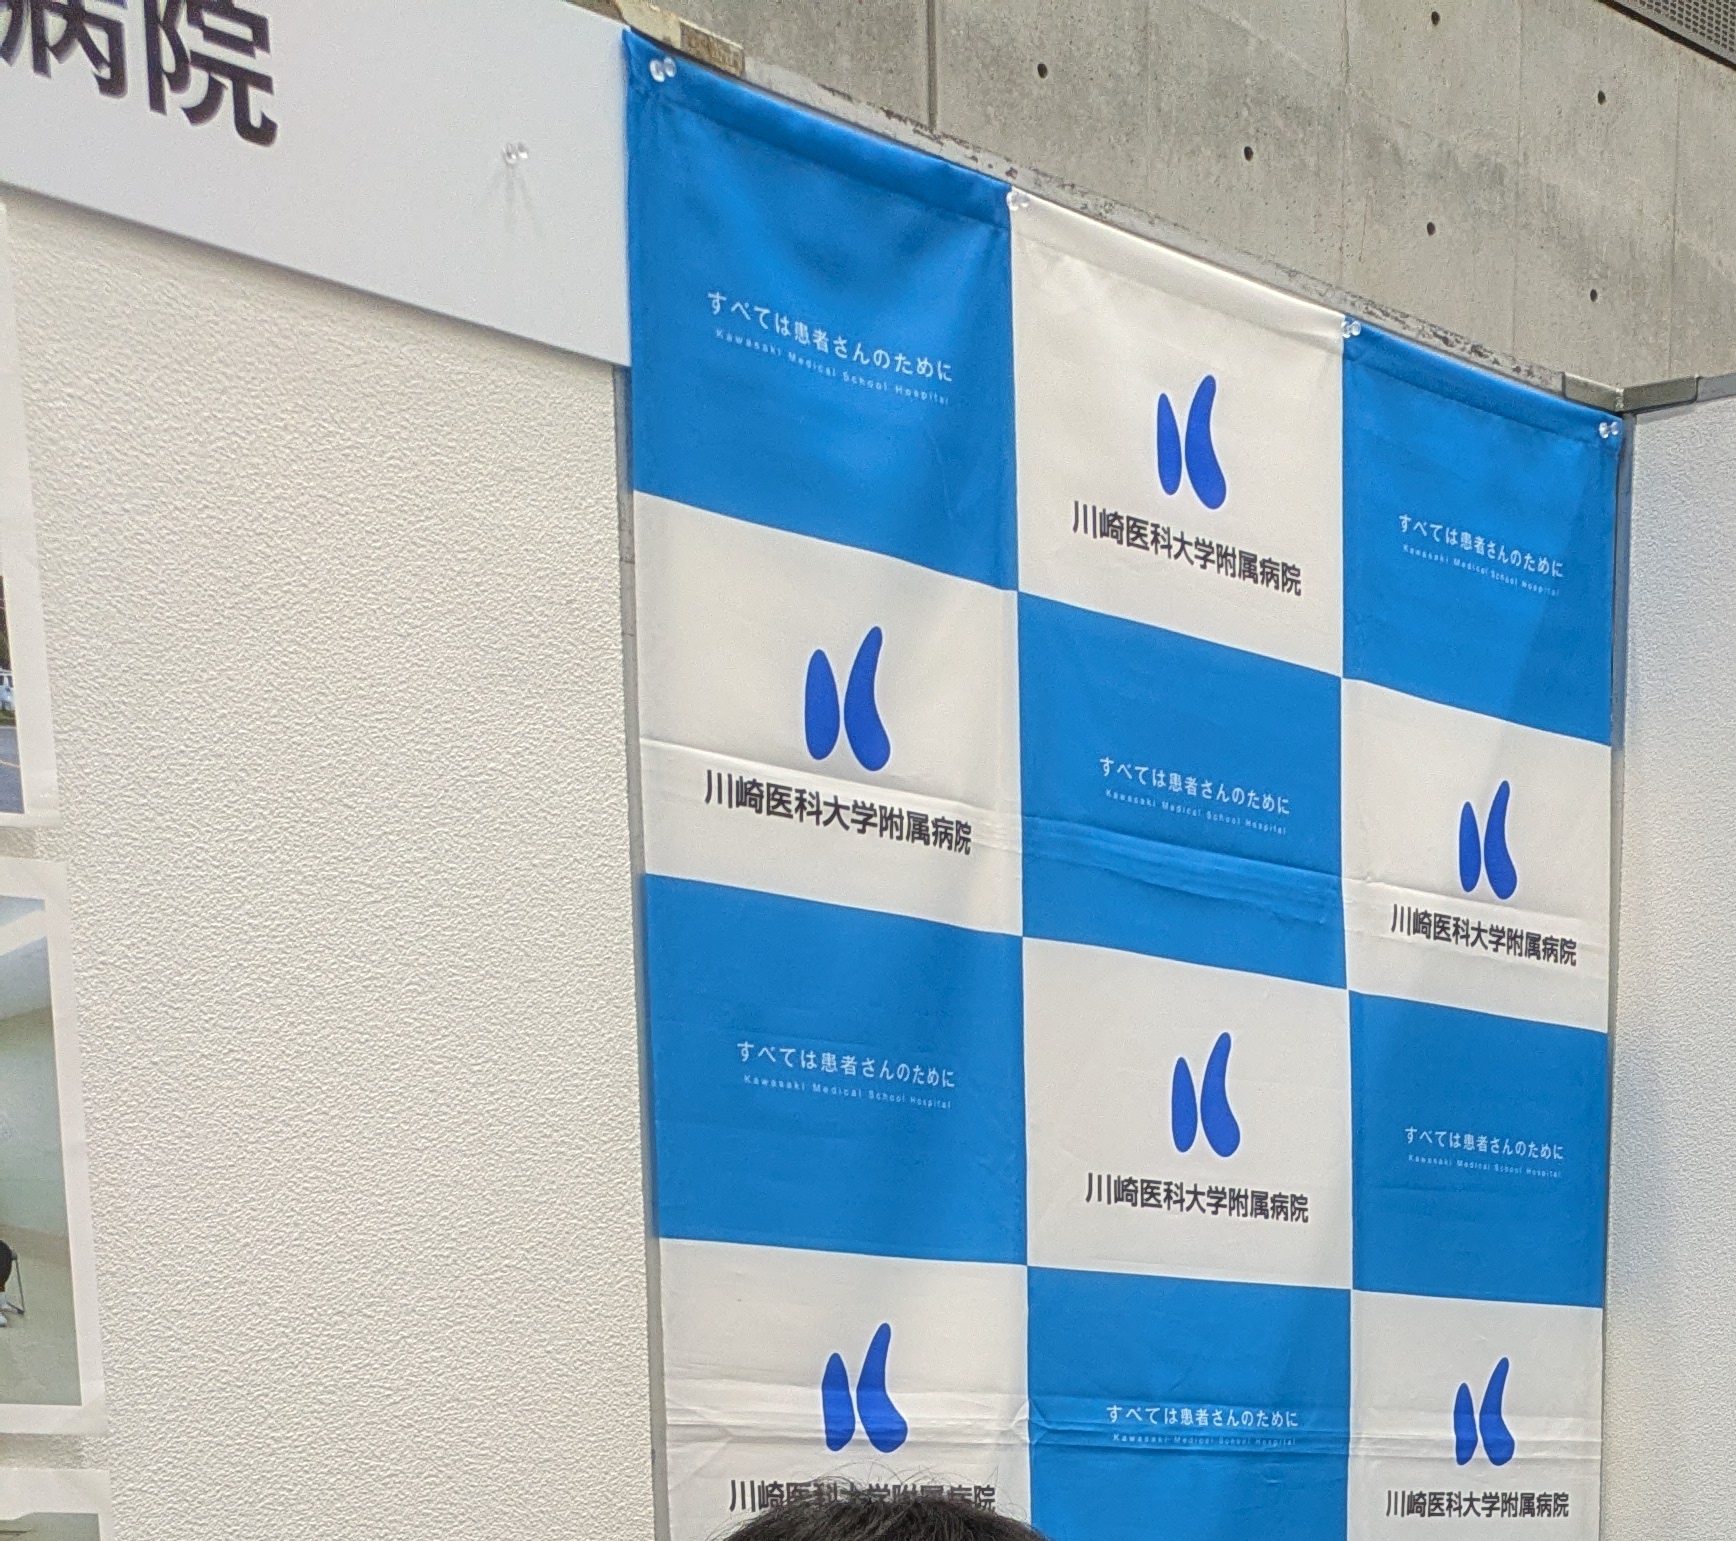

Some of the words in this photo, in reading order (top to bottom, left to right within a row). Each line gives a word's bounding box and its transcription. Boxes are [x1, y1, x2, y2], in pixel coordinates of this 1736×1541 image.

[0, 0, 278, 147] 病院
[707, 291, 952, 381] すべては患者さんのために
[716, 328, 780, 355] Kawasaki
[788, 351, 836, 374] Medical
[842, 370, 887, 389] School
[895, 384, 948, 404] Hospital
[1072, 500, 1302, 596] 川崎医科大学附属病院
[1398, 514, 1562, 577] すべては患者さんのために
[705, 770, 972, 855] 川崎医科大学附属病院
[1099, 756, 1289, 814] すべては患者さんのために
[1391, 904, 1577, 967] 川崎医科大学附属病院
[736, 1041, 954, 1087] すべては患者さんのために
[812, 1082, 861, 1097] Medical
[1404, 1126, 1563, 1159] すべては患者さんのために
[1085, 1172, 1309, 1223] 川崎医科大学附属病院
[1106, 1404, 1298, 1427] すべては患者さんのために
[1386, 1490, 1570, 1519] 川崎医科大学附属病院
